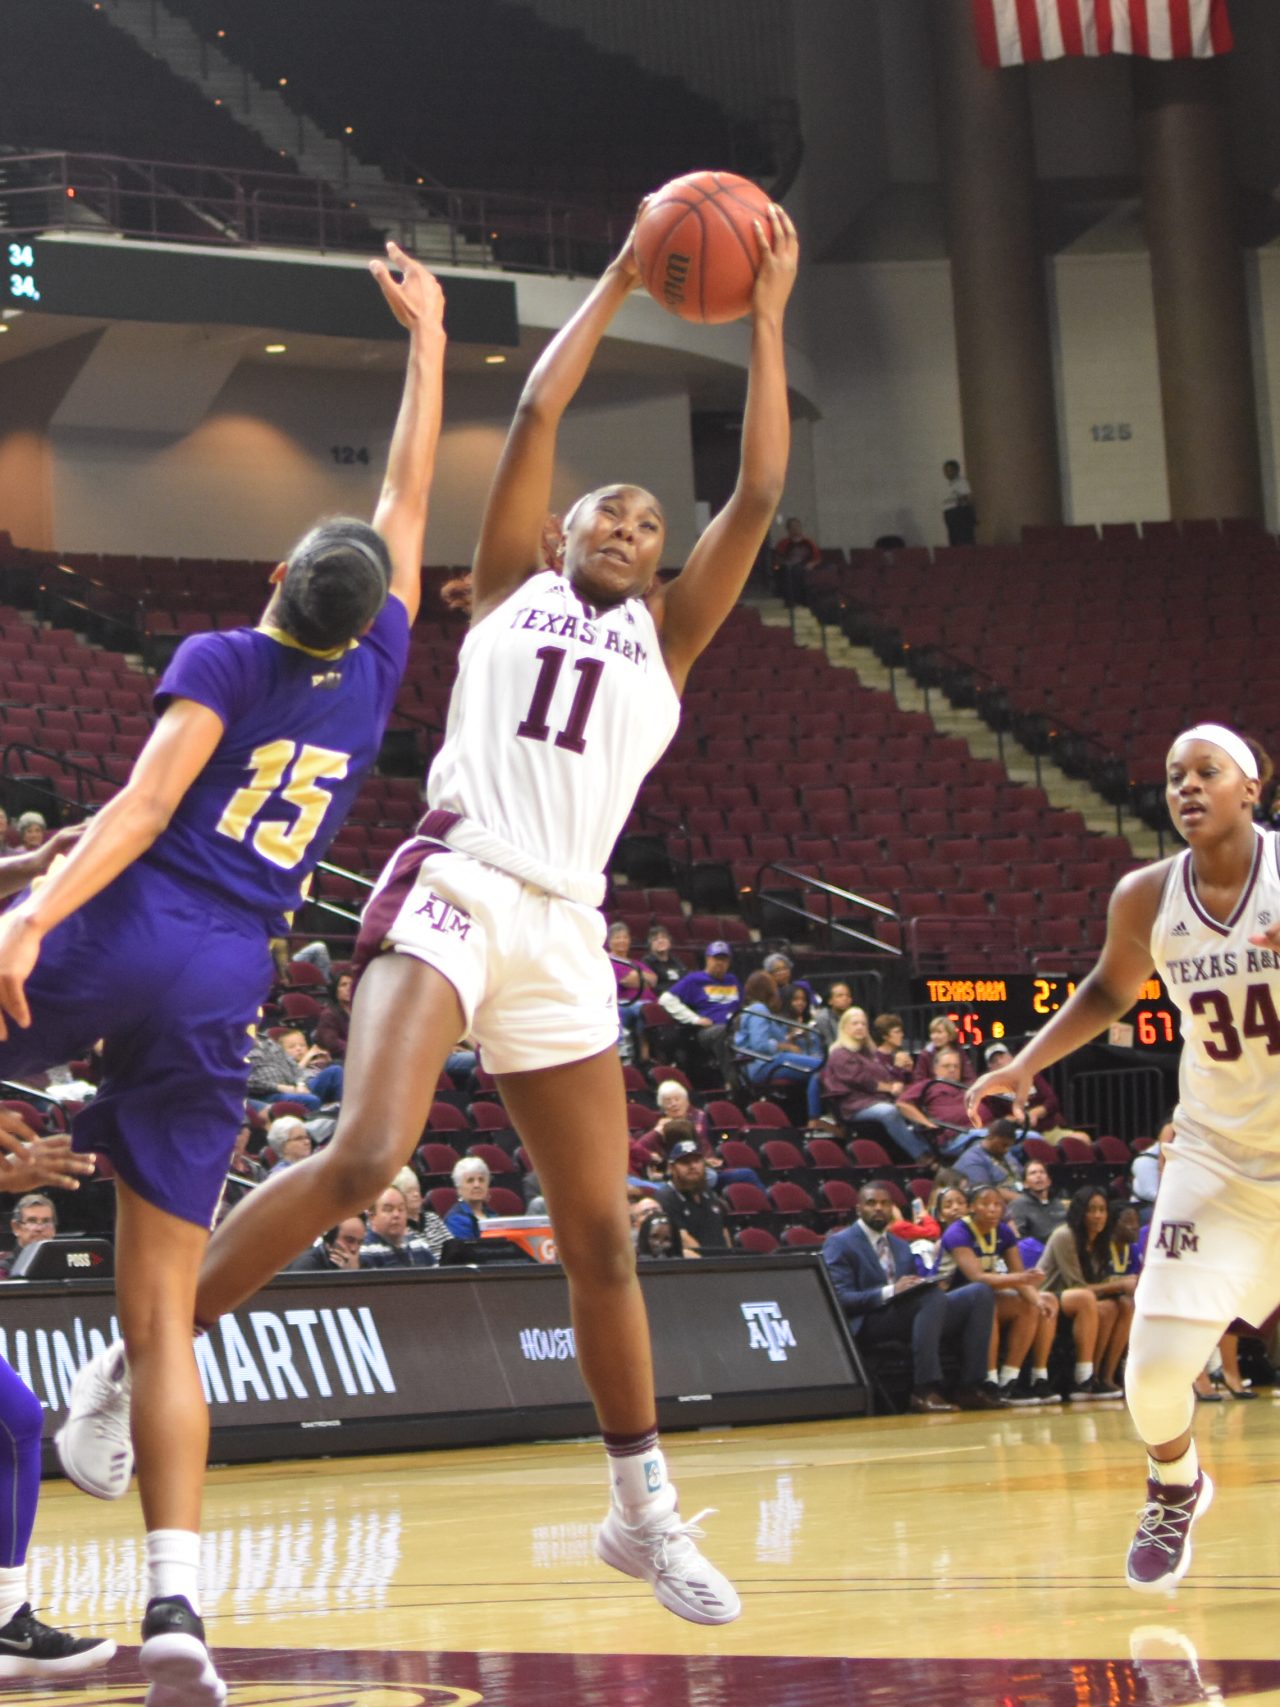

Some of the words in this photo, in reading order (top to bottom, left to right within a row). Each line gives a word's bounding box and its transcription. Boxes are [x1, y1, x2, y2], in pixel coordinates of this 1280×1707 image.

[9, 243, 34, 267] 34
[510, 607, 598, 646] TEXAS
[516, 645, 606, 755] 11
[215, 738, 351, 870] 15
[1166, 951, 1237, 985] TEXAS
[926, 980, 975, 1002] TEXAS
[1138, 1010, 1173, 1045] 67
[1189, 983, 1280, 1062] 34
